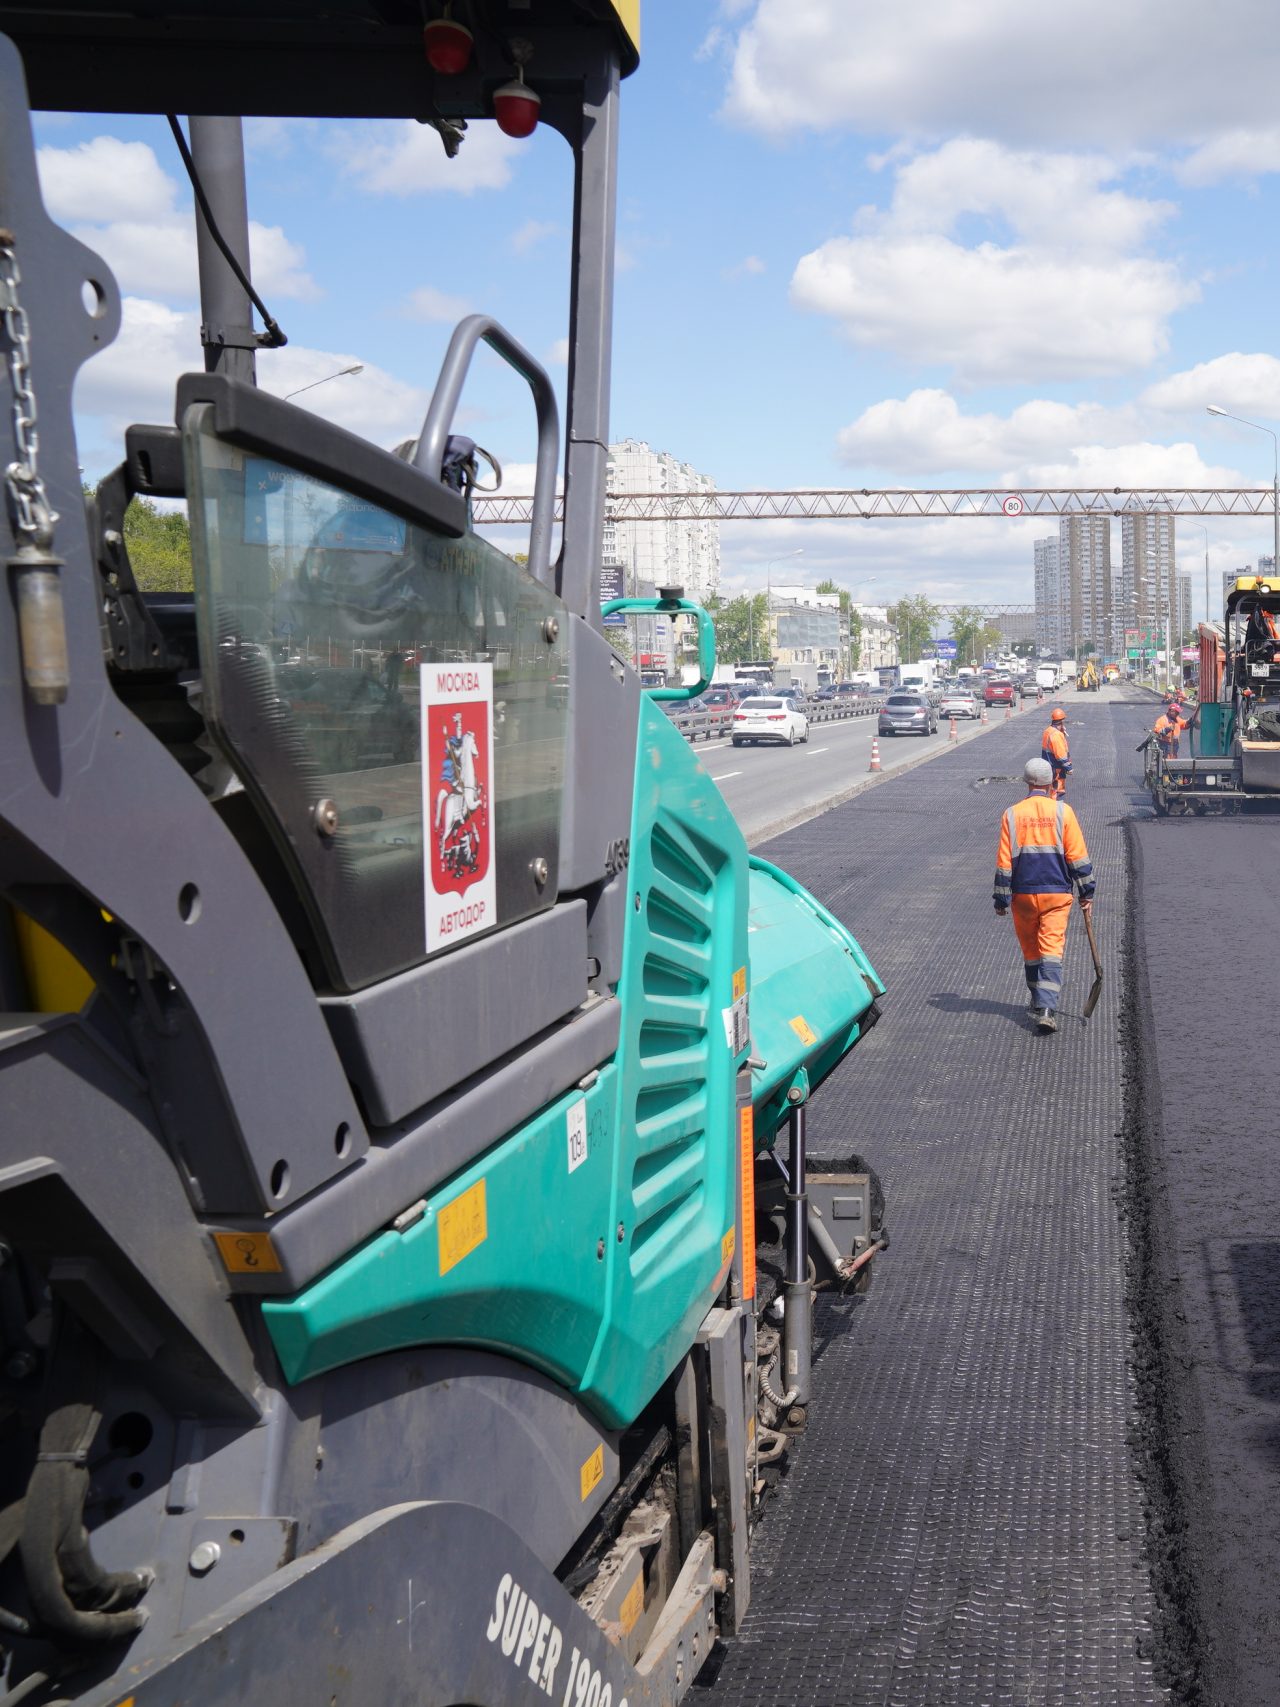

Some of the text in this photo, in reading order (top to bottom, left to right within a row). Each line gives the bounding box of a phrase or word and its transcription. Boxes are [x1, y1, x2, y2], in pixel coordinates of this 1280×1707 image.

[1007, 502, 1019, 511] 80
[437, 671, 480, 693] МОСКВА
[439, 901, 486, 937] АВТОДОР
[570, 1129, 582, 1163] 109
[486, 1573, 563, 1697] SUPER
